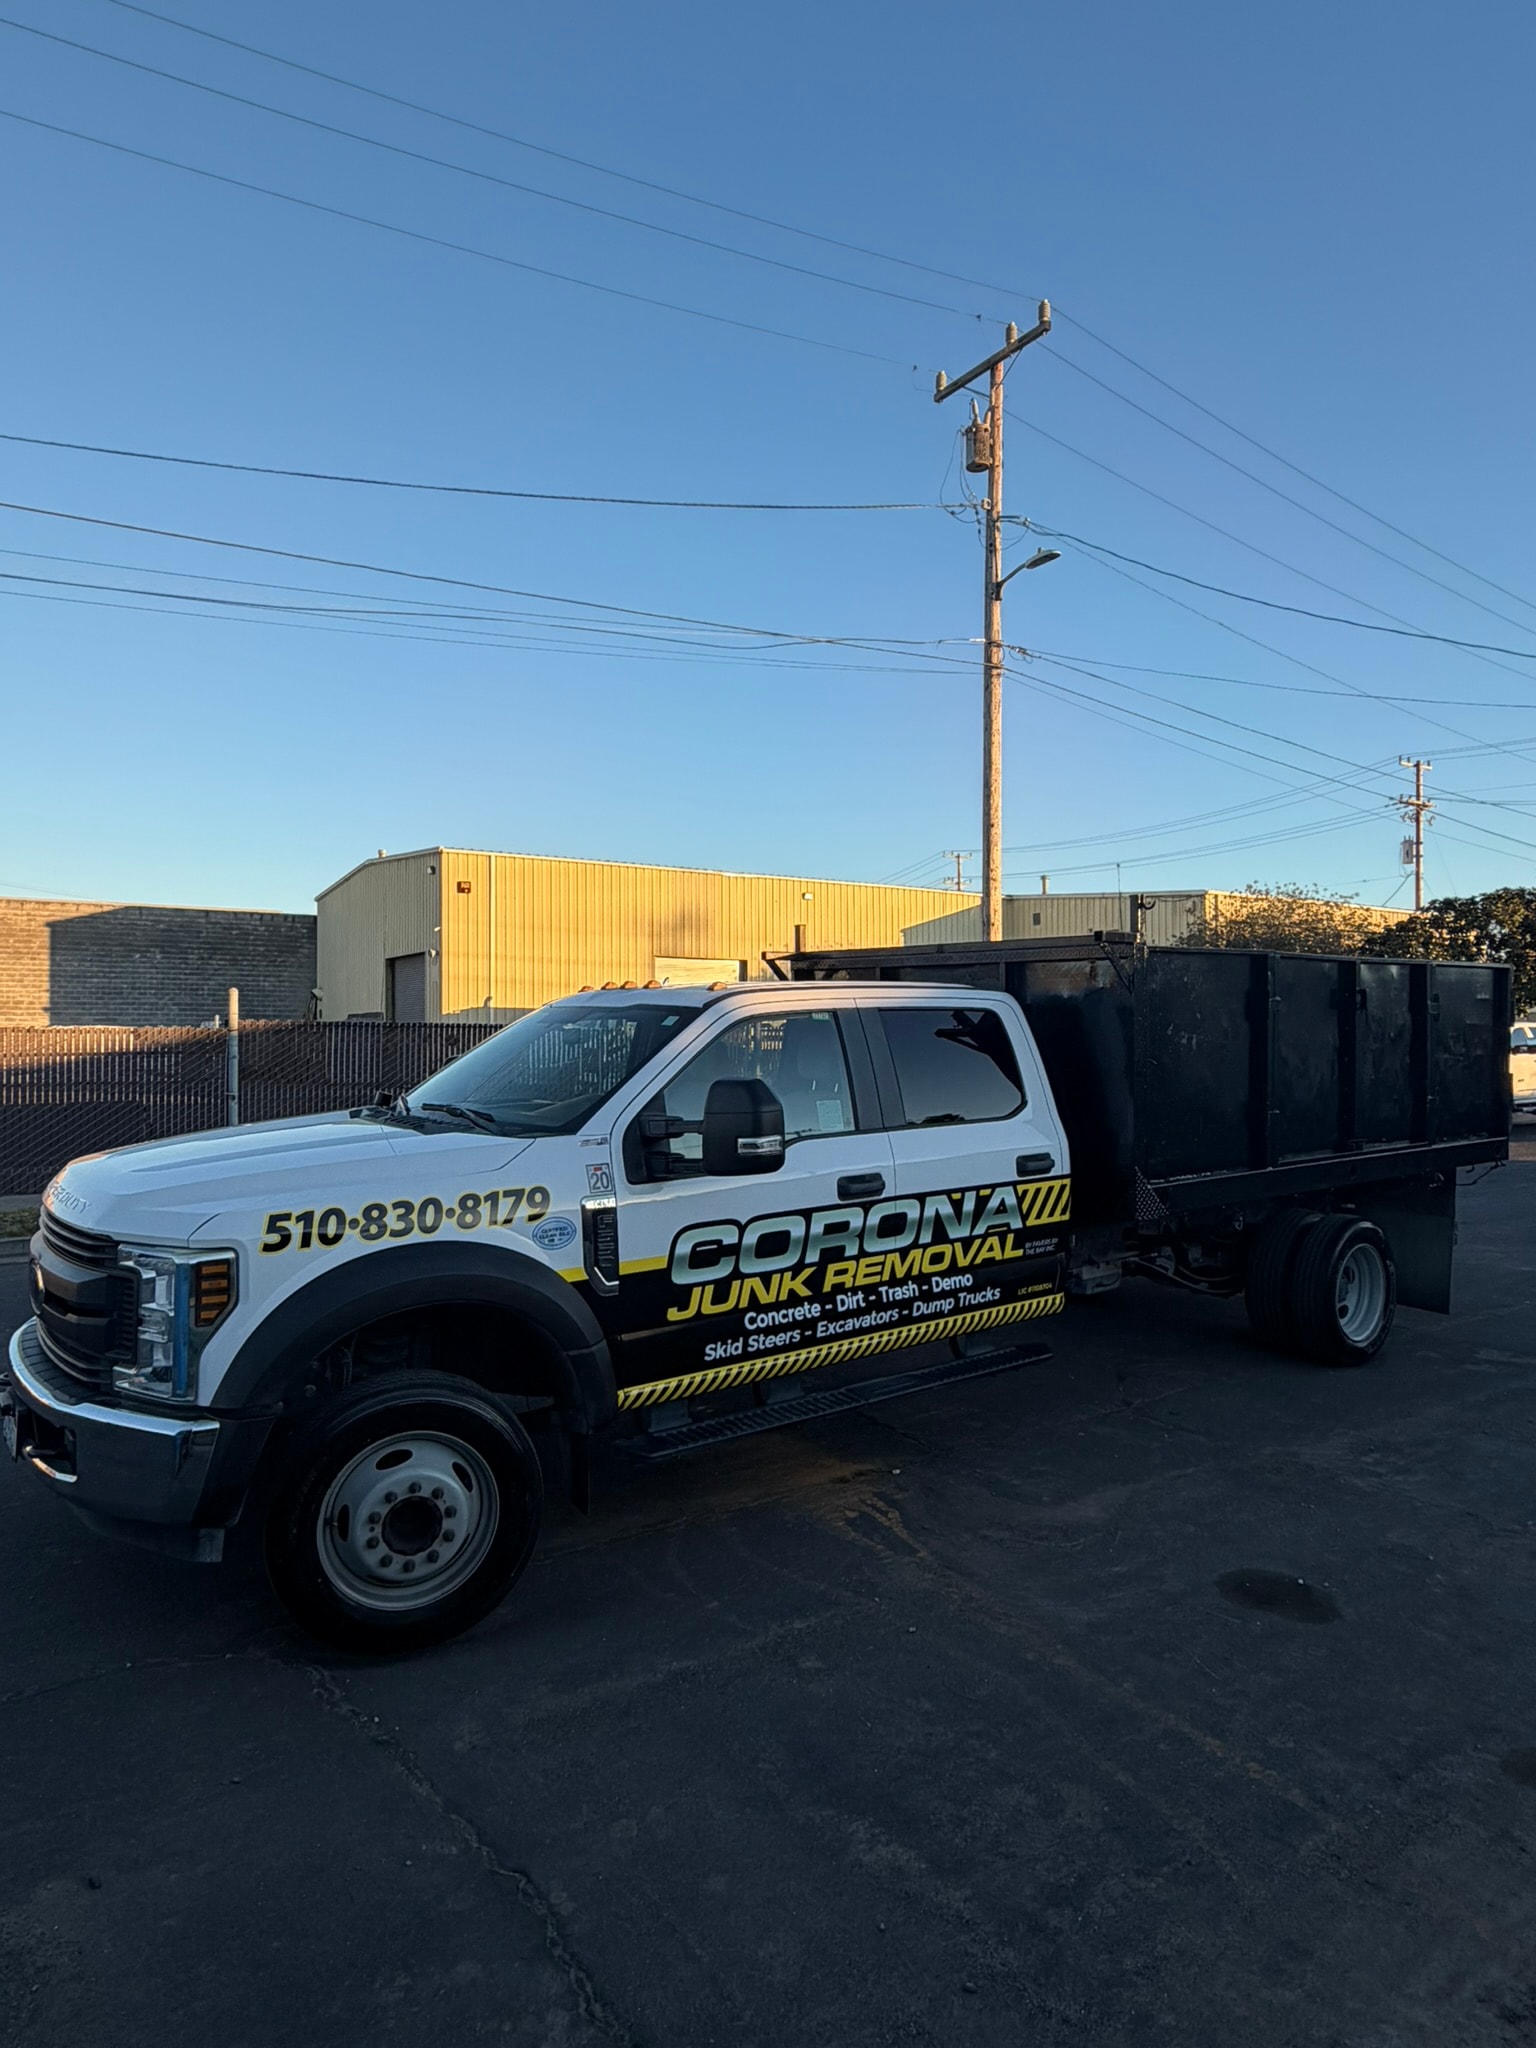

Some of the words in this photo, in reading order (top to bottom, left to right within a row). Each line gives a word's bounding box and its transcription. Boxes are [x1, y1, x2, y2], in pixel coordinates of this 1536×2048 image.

[59, 1191, 92, 1214] DUTY
[590, 1172, 610, 1190] 20
[671, 1186, 1023, 1285] CORONA
[667, 1267, 817, 1321] JUNK
[822, 1233, 1024, 1293] REMOVAL
[744, 1301, 821, 1330] Concrete
[836, 1290, 866, 1312] Dirt
[878, 1281, 919, 1303] Trash
[931, 1273, 973, 1293] Demo
[704, 1337, 743, 1361] Skid
[747, 1328, 801, 1352] Steers
[816, 1307, 899, 1338] Excavators
[912, 1297, 954, 1317] Dump
[958, 1286, 1001, 1307] Trucks
